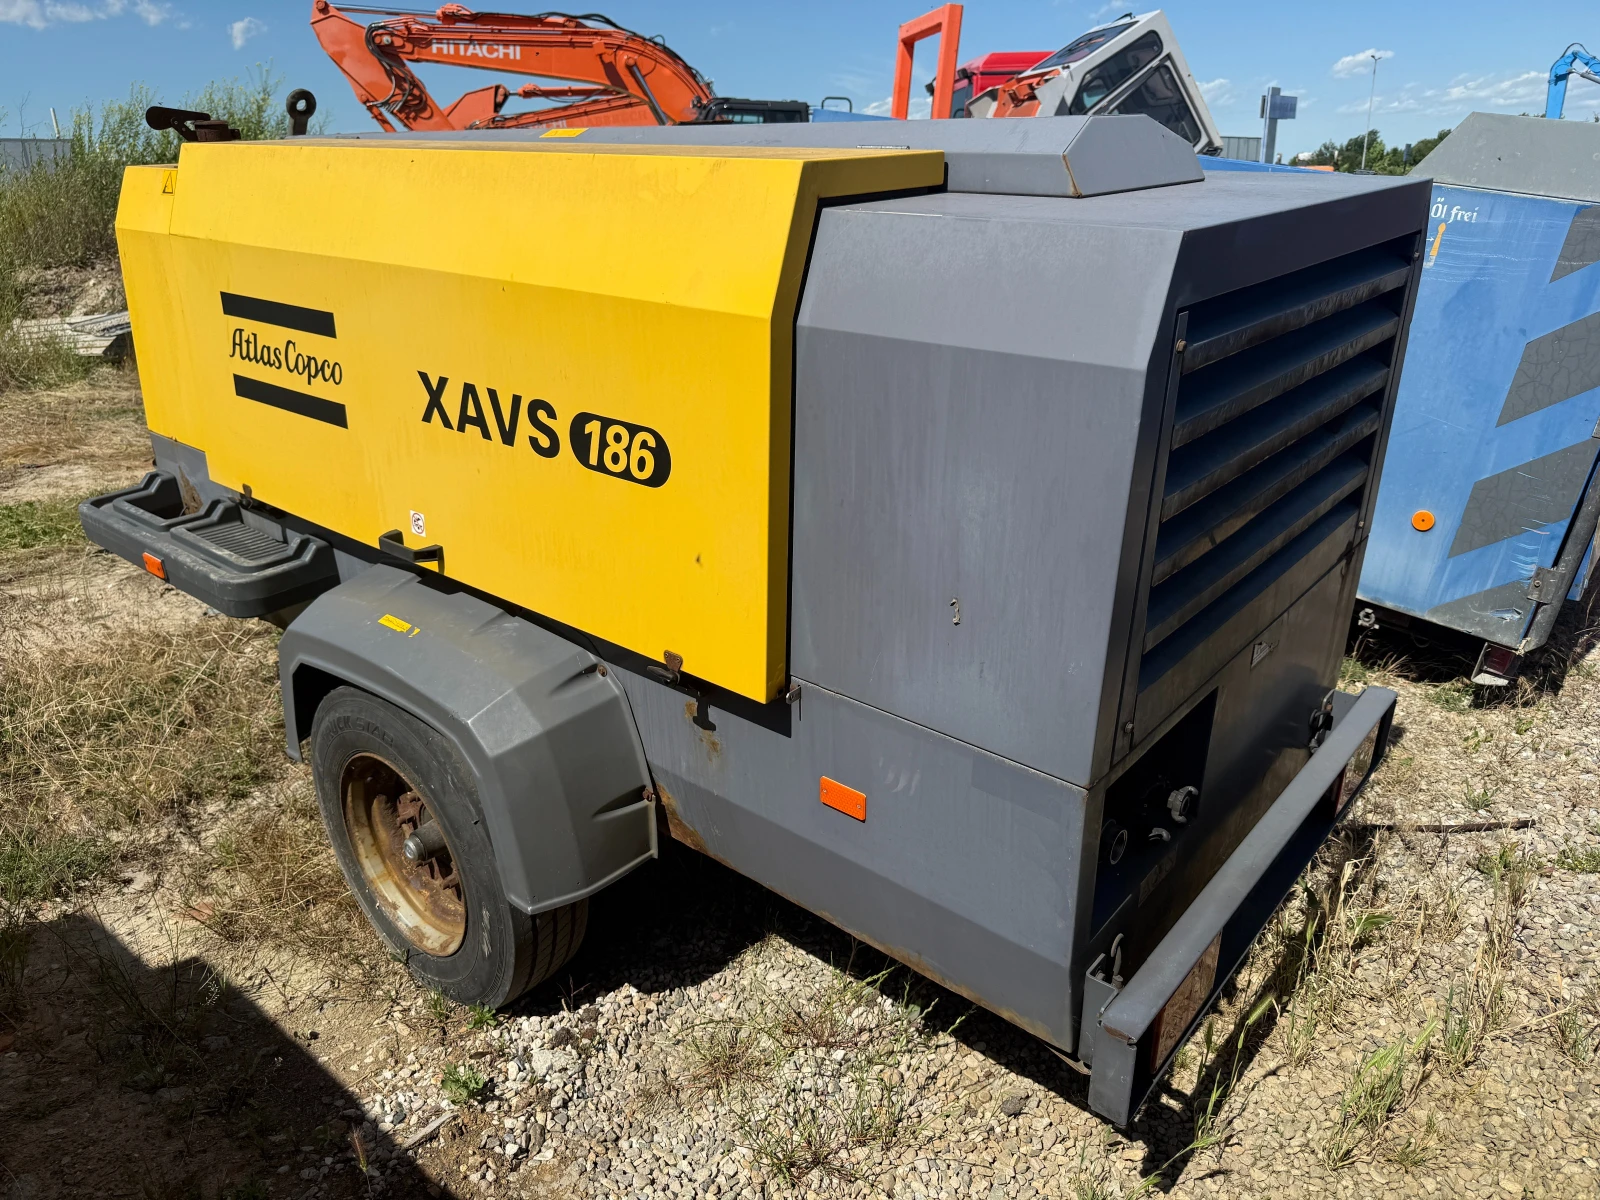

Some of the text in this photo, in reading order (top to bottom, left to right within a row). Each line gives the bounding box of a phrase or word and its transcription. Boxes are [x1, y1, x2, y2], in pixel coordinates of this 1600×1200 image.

[431, 39, 521, 60] HITACHI
[1431, 197, 1480, 224] Öl frei
[229, 328, 343, 386] Atlas Copco
[417, 370, 657, 480] XAVS 186
